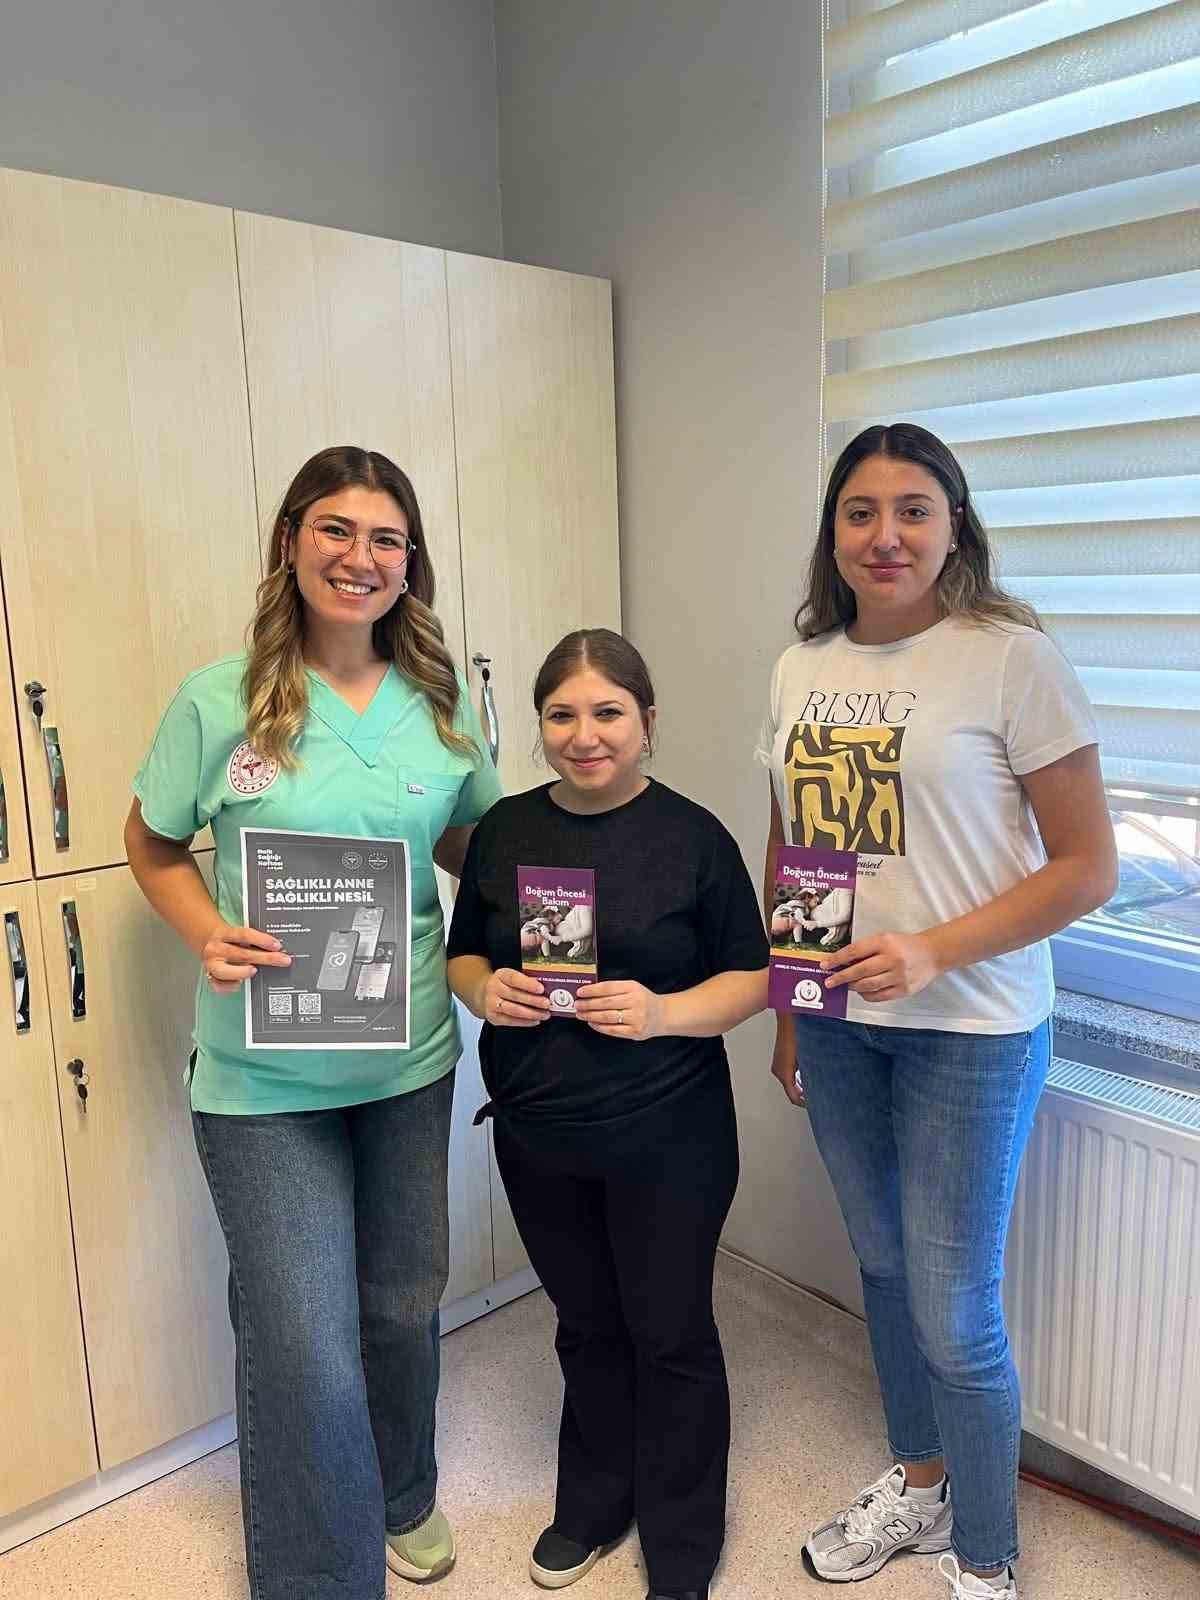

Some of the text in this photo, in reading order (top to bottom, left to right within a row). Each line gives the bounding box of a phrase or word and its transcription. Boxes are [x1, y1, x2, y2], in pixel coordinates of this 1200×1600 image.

[796, 690, 917, 724] RISING
[783, 866, 848, 881] Doğum Öncesi
[265, 876, 375, 890] SAĞLIKLI ANNE
[799, 878, 829, 889] Bakım
[265, 890, 331, 903] SAĞLIKLI
[525, 885, 586, 898] Doğum Öncesi
[882, 1519, 912, 1542] N
